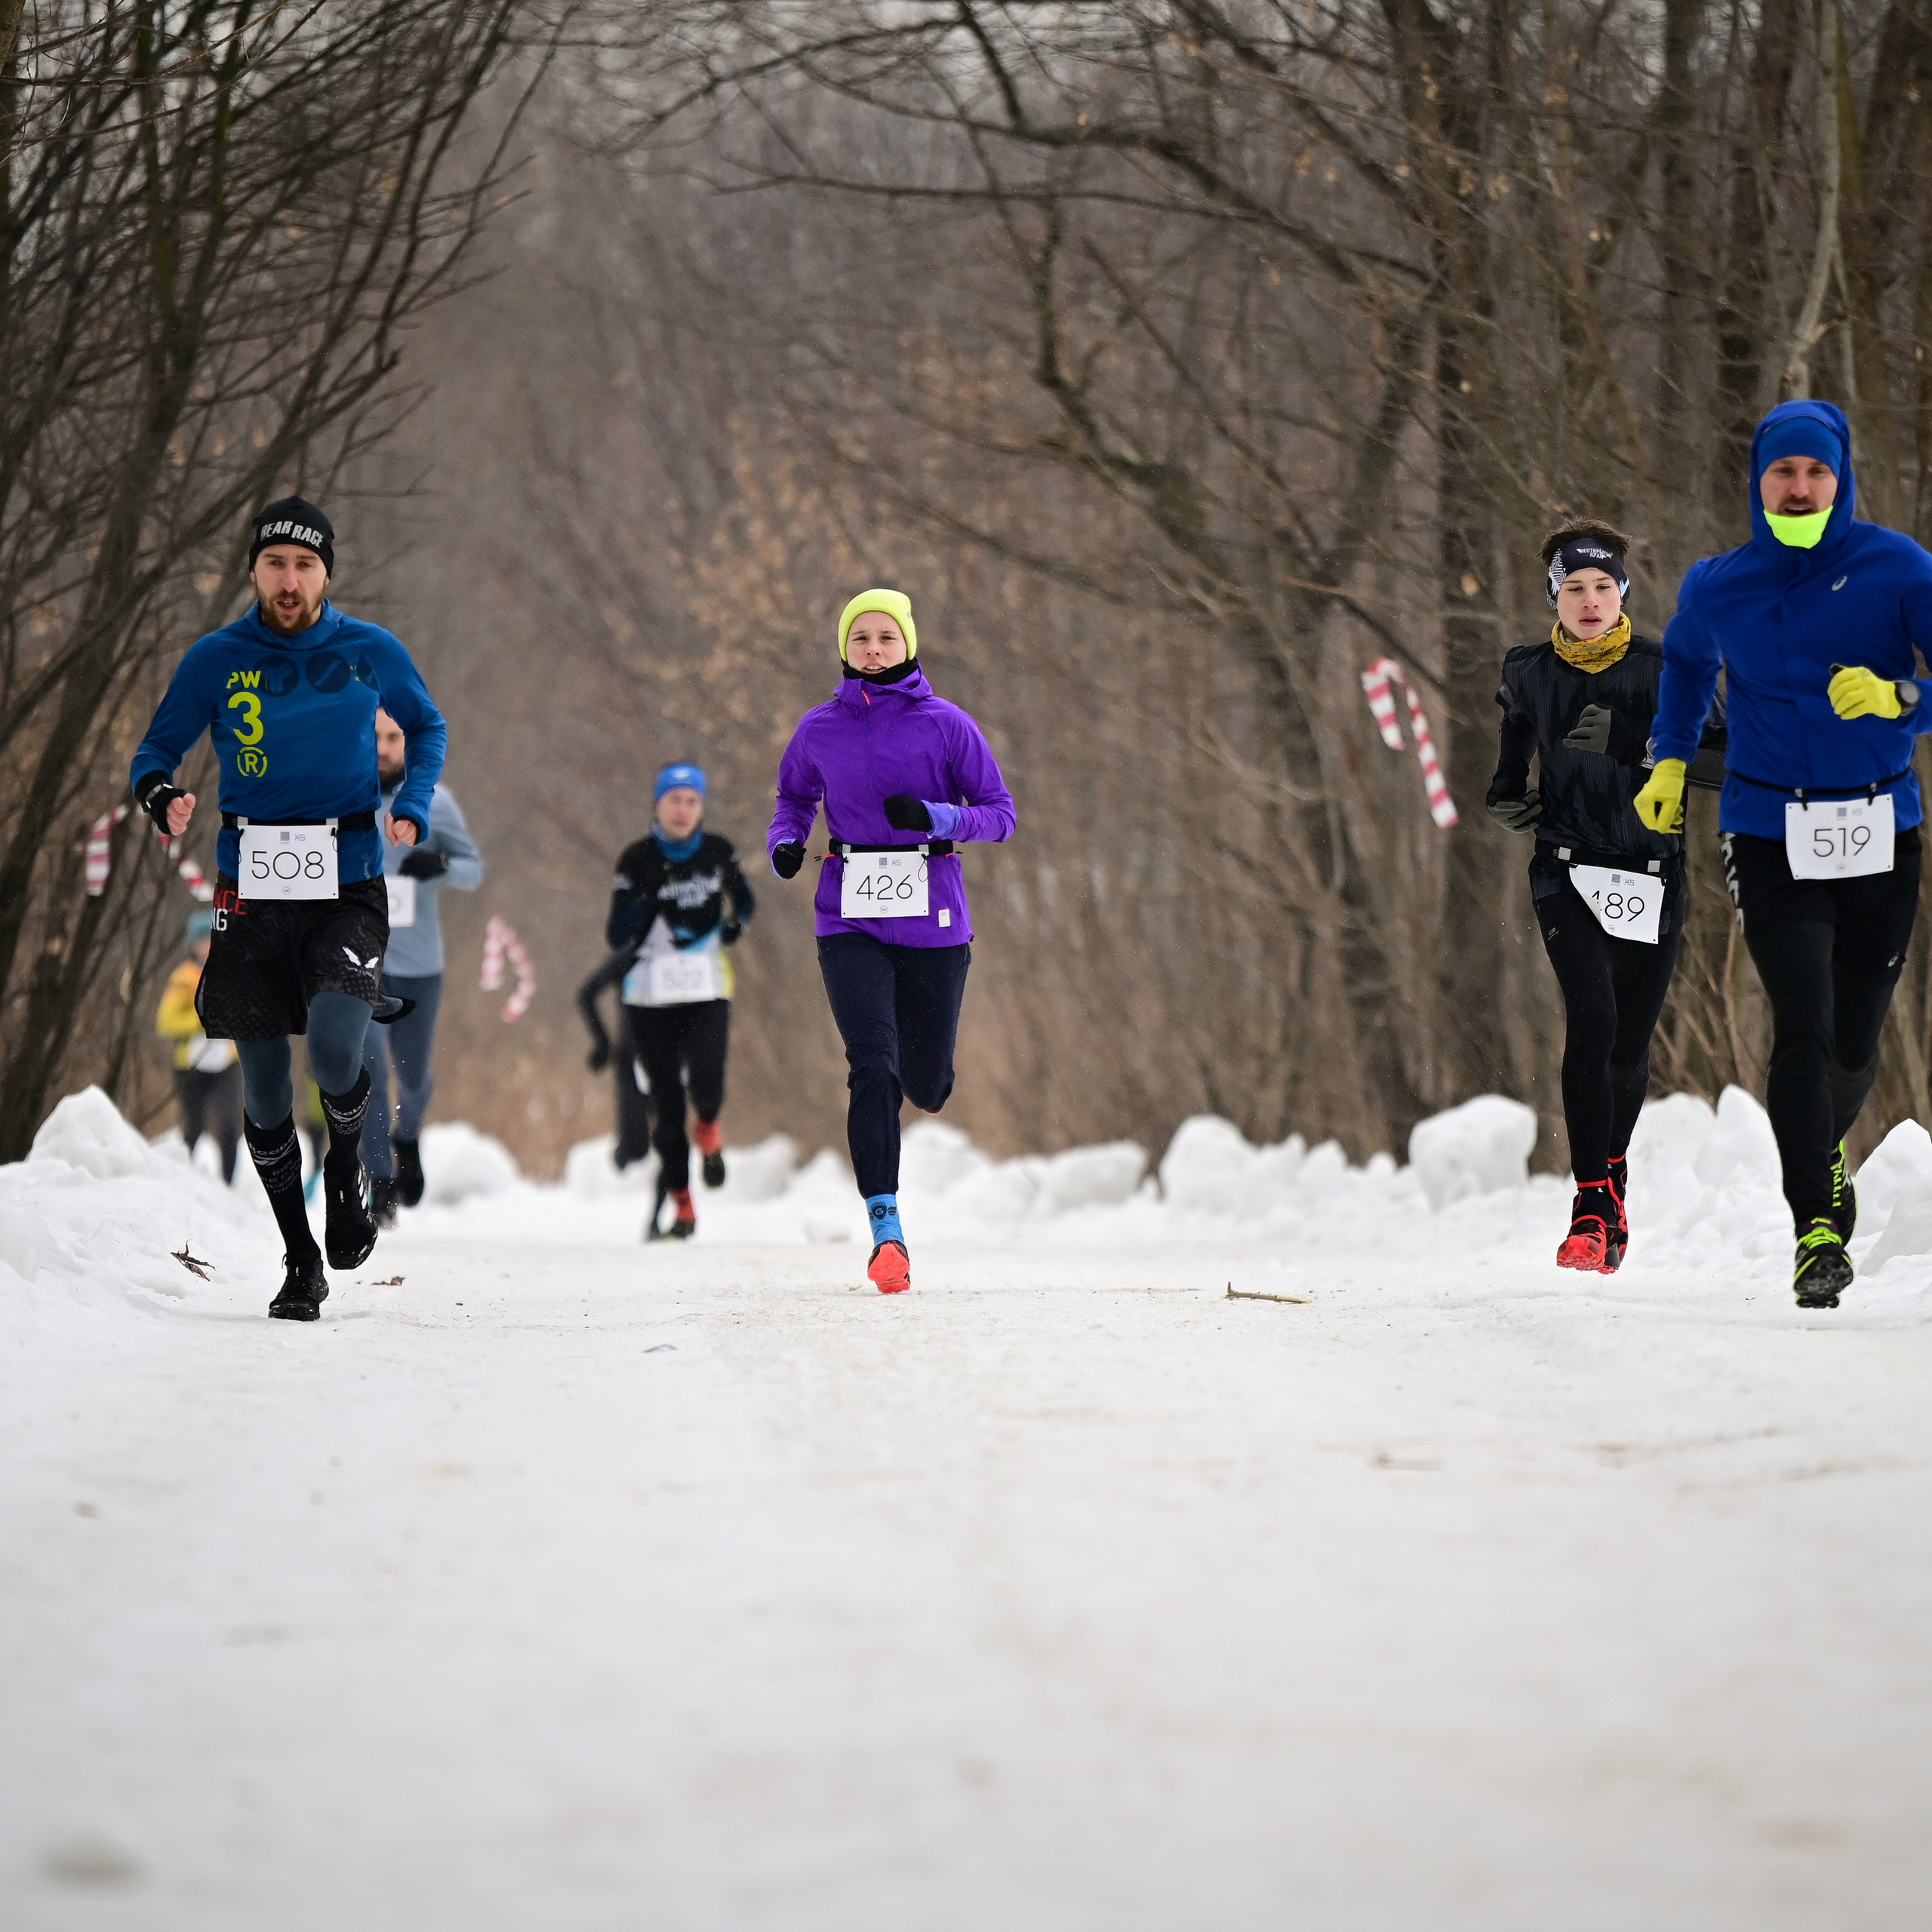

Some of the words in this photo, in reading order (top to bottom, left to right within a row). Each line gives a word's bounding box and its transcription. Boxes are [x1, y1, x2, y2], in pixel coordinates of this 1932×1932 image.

[291, 525, 324, 548] RACE
[227, 691, 264, 746] 3
[1813, 826, 1872, 857] 519
[251, 851, 325, 880] 508
[856, 873, 913, 900] 426
